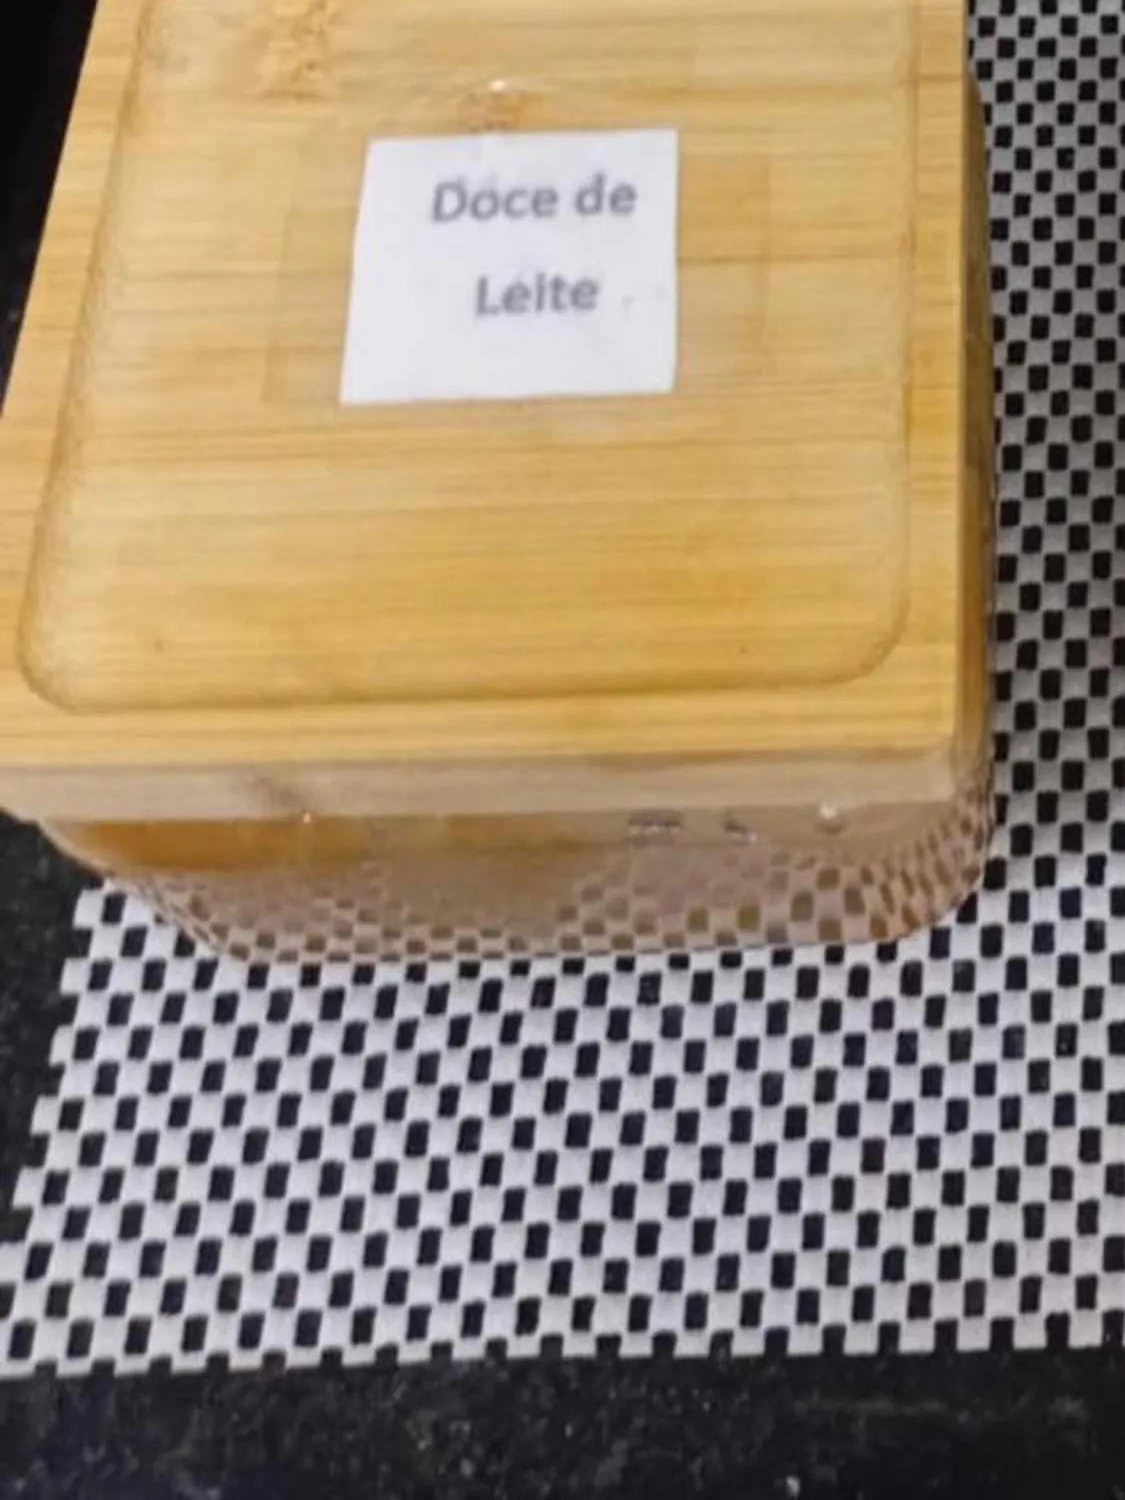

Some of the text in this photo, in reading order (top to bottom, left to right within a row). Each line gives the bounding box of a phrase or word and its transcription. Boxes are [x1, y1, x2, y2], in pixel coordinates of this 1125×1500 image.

[431, 171, 639, 224] Doce de
[474, 271, 601, 318] Leite
